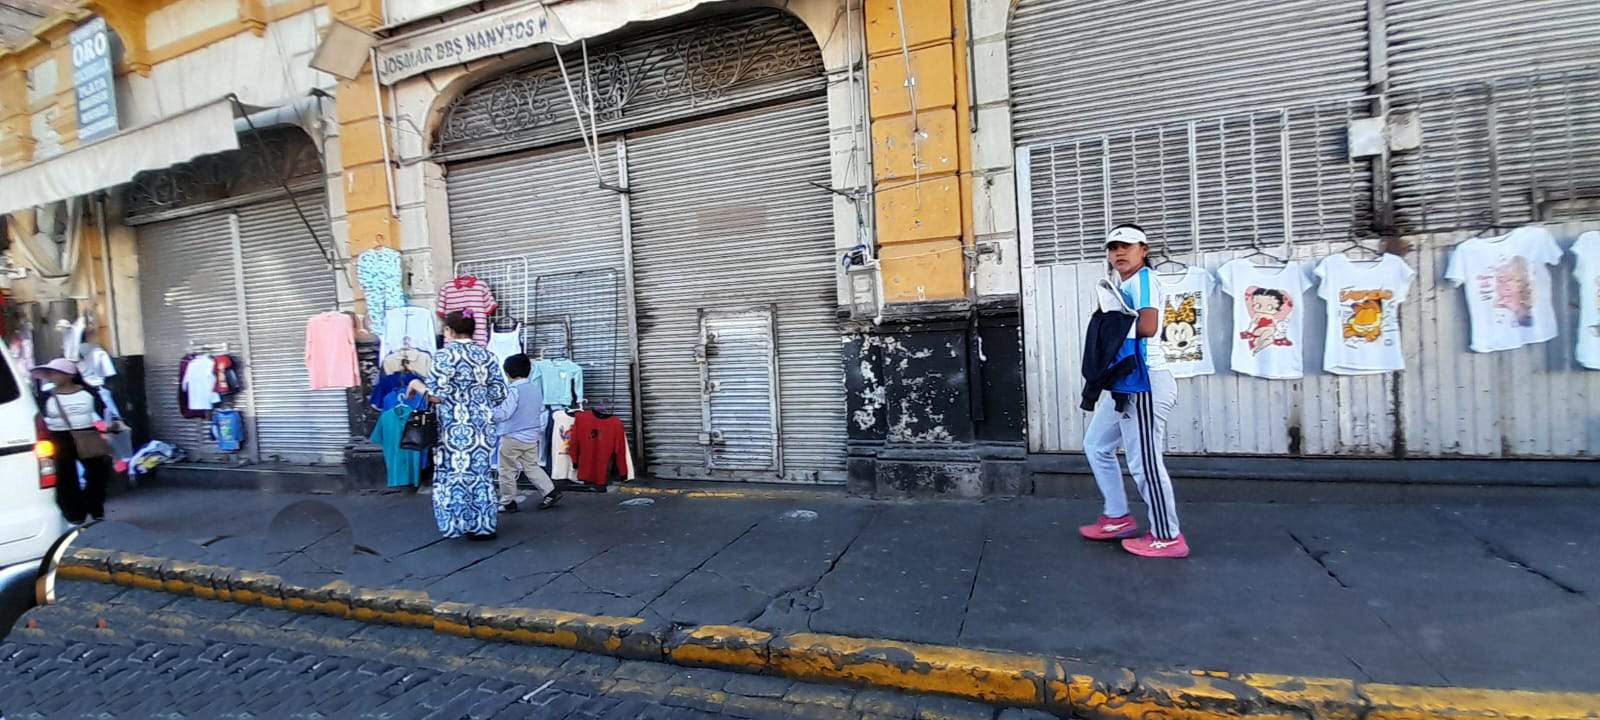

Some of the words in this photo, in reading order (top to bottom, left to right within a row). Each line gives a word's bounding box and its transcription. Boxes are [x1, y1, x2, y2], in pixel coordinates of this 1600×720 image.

[73, 31, 106, 67] ORO
[382, 47, 433, 75] JOSMAR
[465, 20, 534, 53] NANYTOS
